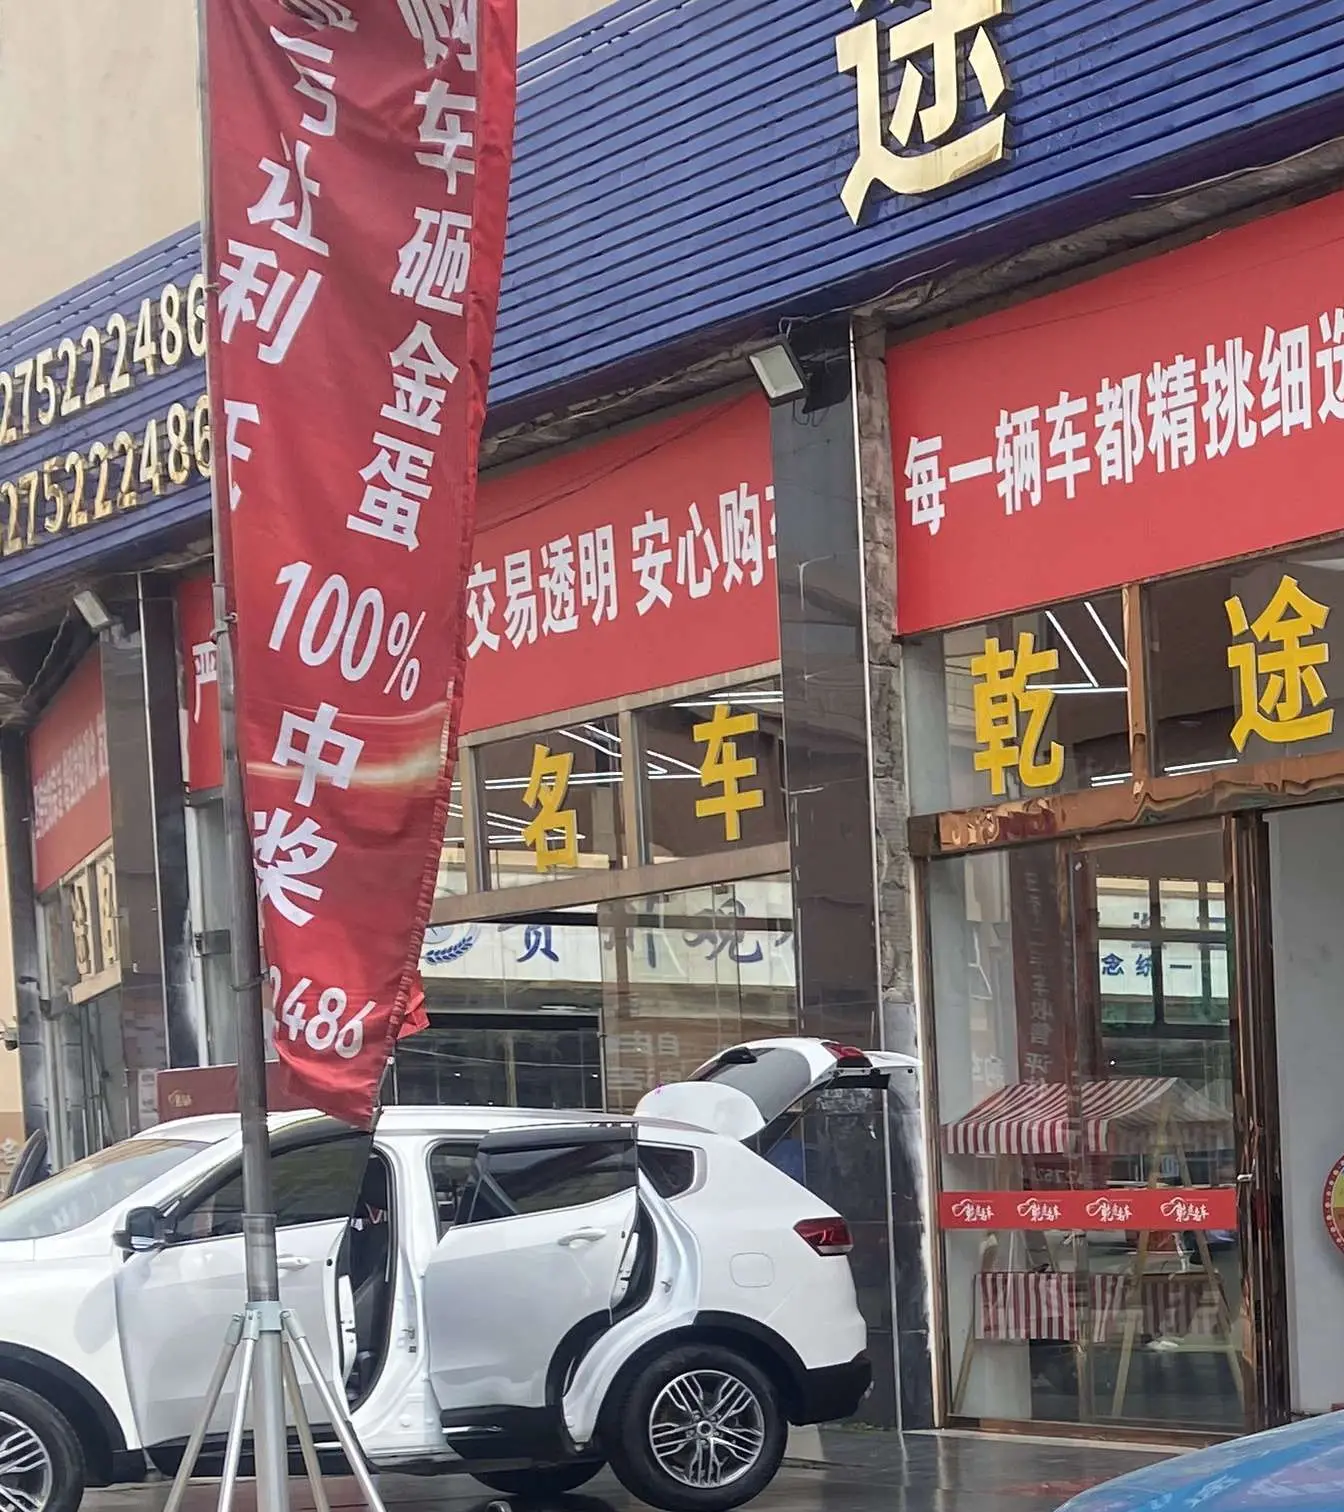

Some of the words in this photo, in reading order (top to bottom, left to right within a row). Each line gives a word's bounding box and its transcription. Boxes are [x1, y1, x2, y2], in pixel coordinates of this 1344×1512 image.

[267, 560, 427, 700] 100%
[466, 525, 618, 657] 交易透明
[631, 482, 776, 616] 安心购
[522, 705, 764, 872] 名车
